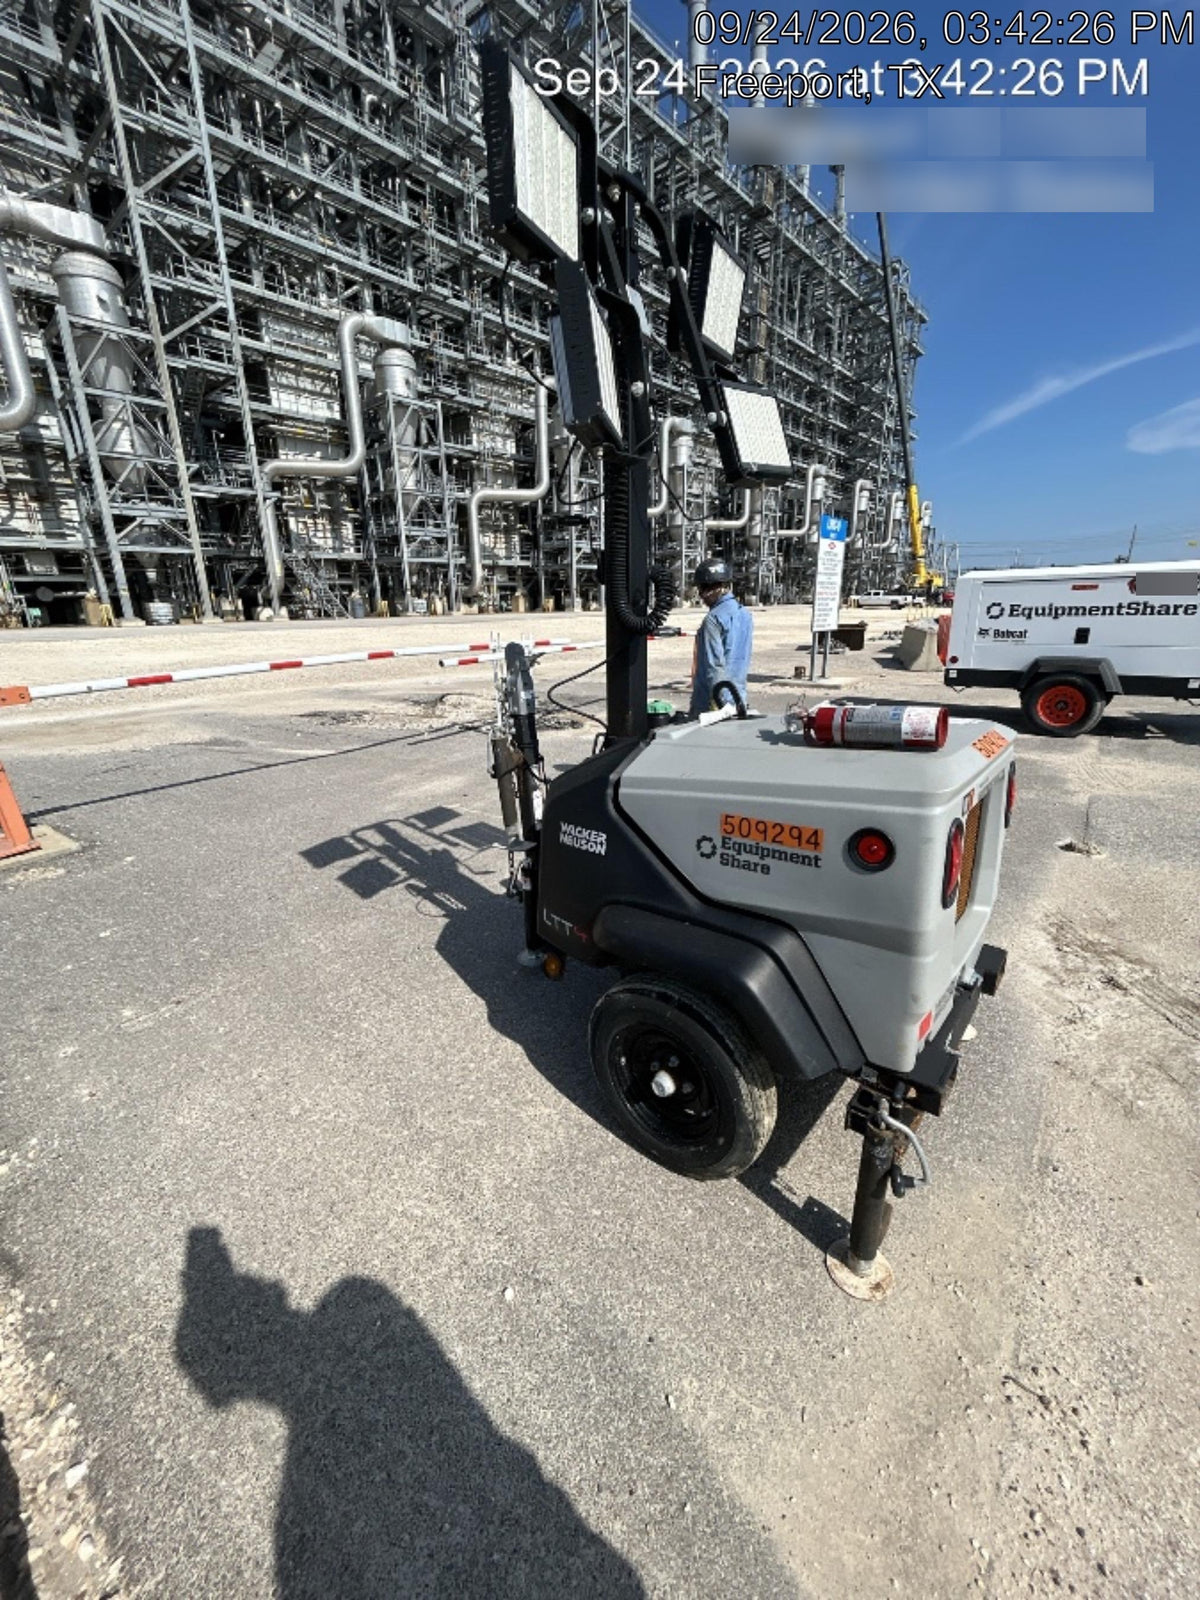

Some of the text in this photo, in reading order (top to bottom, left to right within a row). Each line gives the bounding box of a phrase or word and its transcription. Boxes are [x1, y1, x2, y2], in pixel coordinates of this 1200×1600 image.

[1008, 601, 1198, 620] EquipmentShare
[560, 822, 607, 843] WACKER
[722, 814, 821, 850] 509294
[560, 833, 607, 855] NEUSON
[721, 835, 822, 868] Equipment
[720, 852, 770, 875] Share
